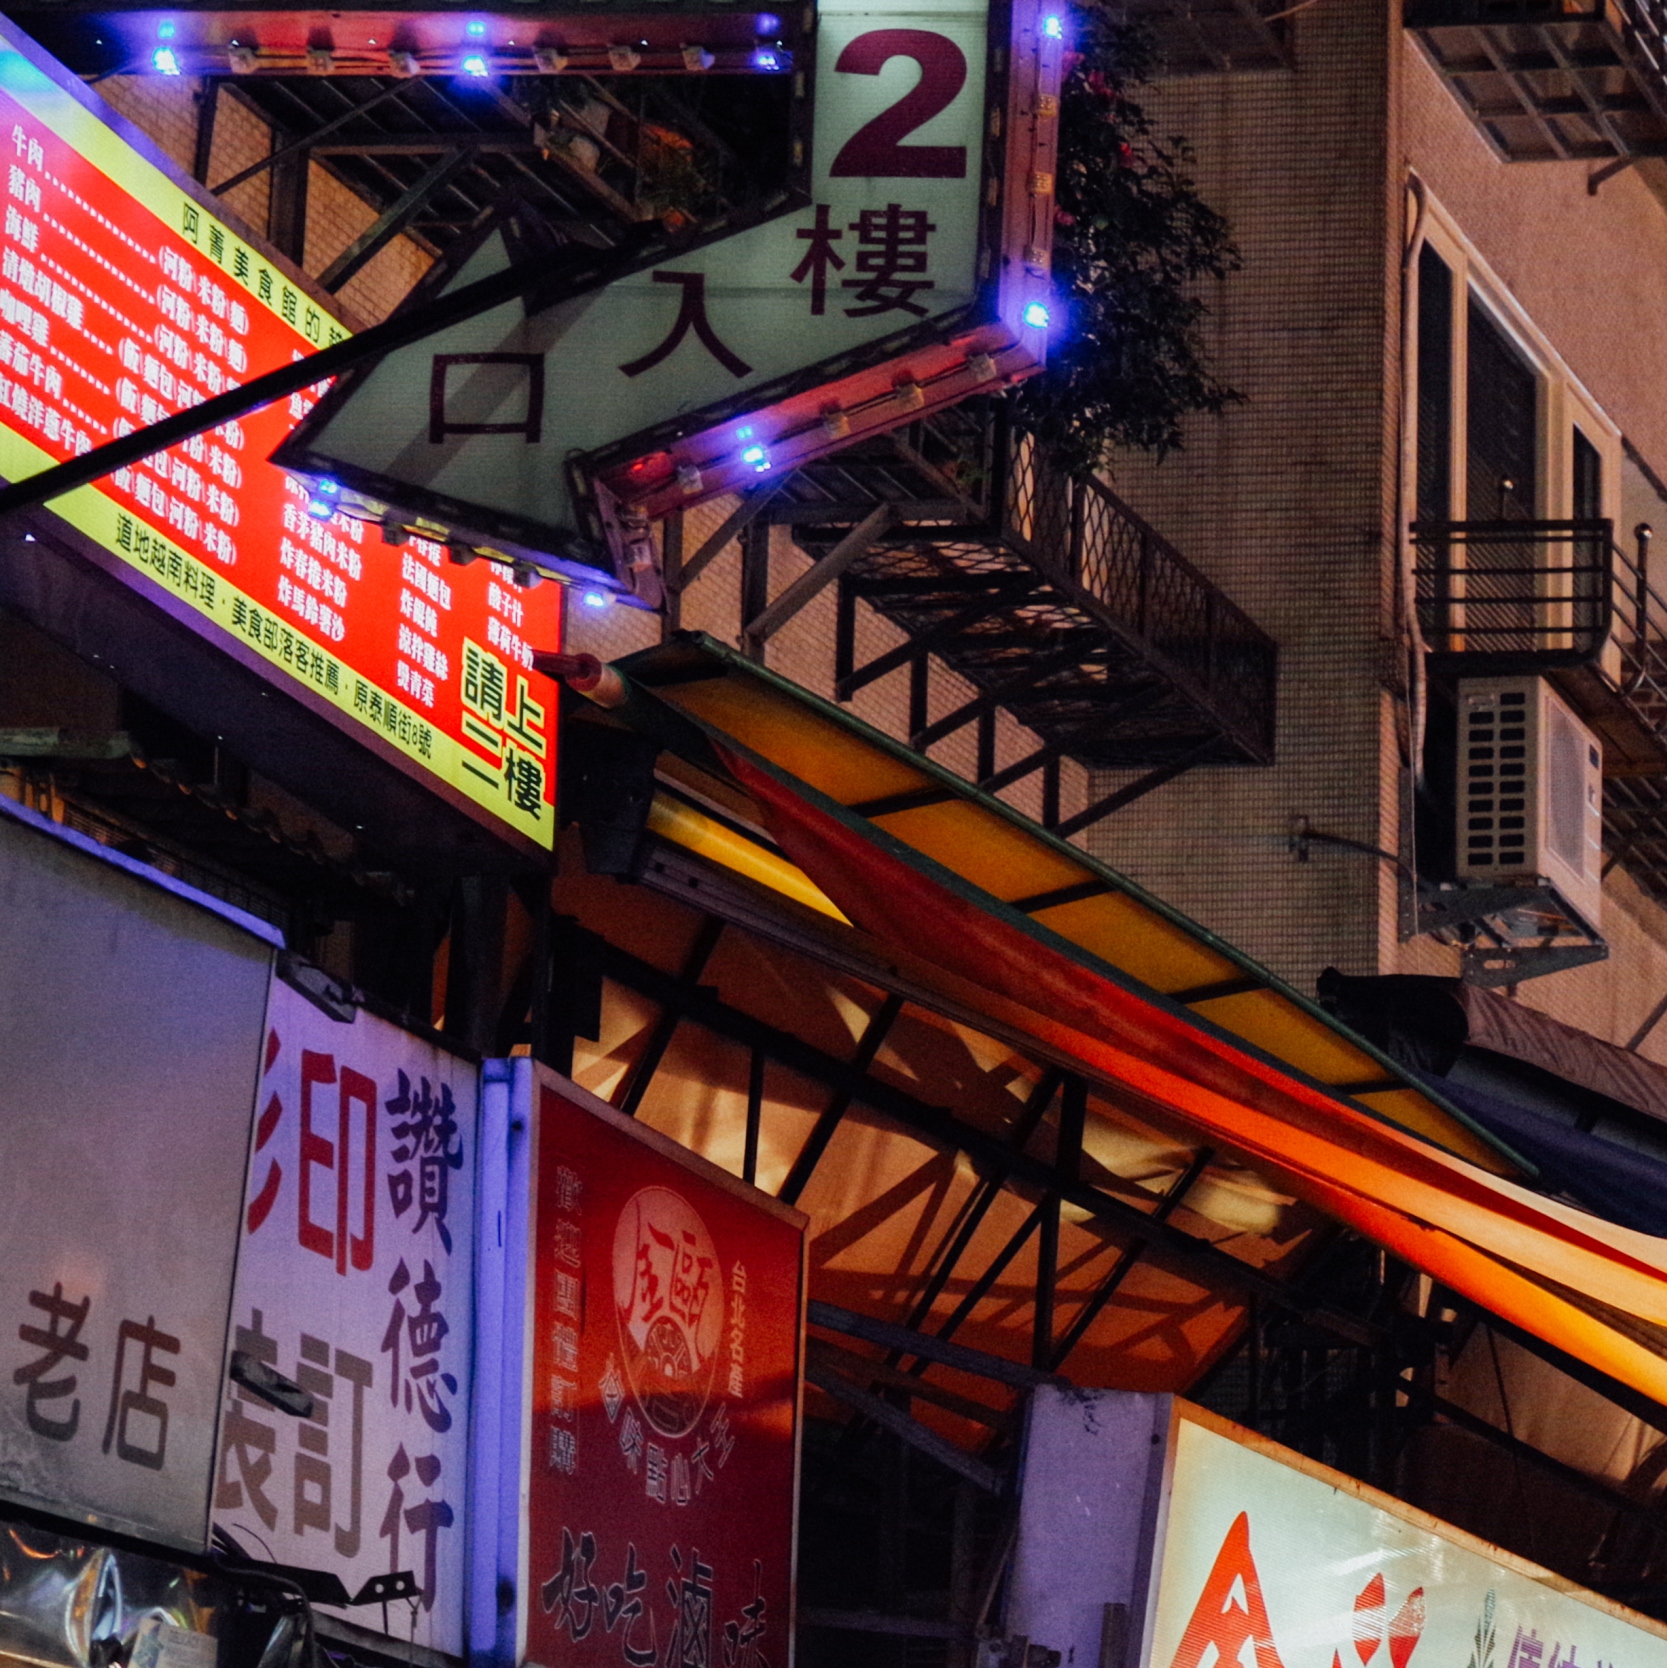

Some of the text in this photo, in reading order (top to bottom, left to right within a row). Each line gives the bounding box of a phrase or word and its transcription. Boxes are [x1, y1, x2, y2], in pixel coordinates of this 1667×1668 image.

[12, 124, 44, 171] 牛肉
[830, 30, 967, 179] 2
[14, 1280, 181, 1472] 老店
[380, 1066, 464, 1614] 讚德行
